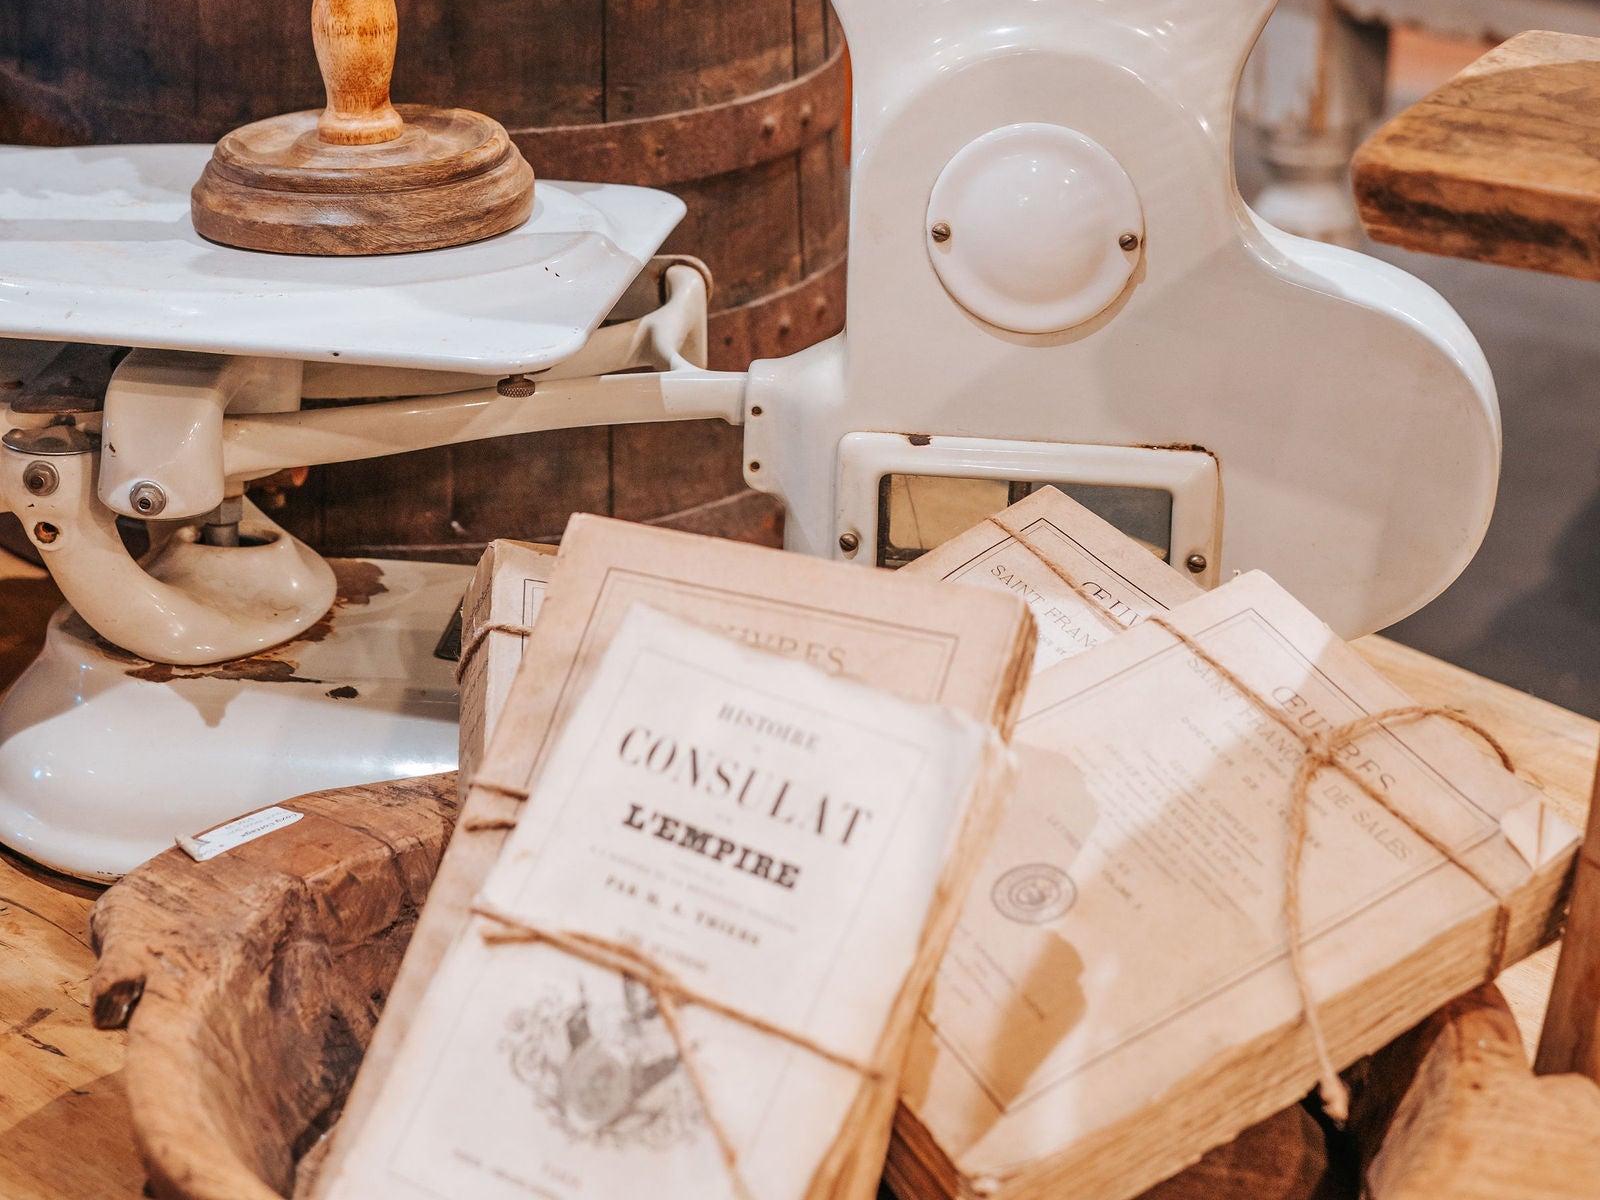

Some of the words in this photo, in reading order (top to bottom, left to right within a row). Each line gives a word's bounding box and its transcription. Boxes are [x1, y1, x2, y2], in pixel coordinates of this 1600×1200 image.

[990, 564, 1046, 605] SAINT
[718, 702, 822, 751] HISTOIRE
[618, 723, 874, 847] CONSULAT
[1322, 783, 1352, 810] DE
[1352, 808, 1414, 862] SALES
[622, 803, 802, 891] L'EMPIRE
